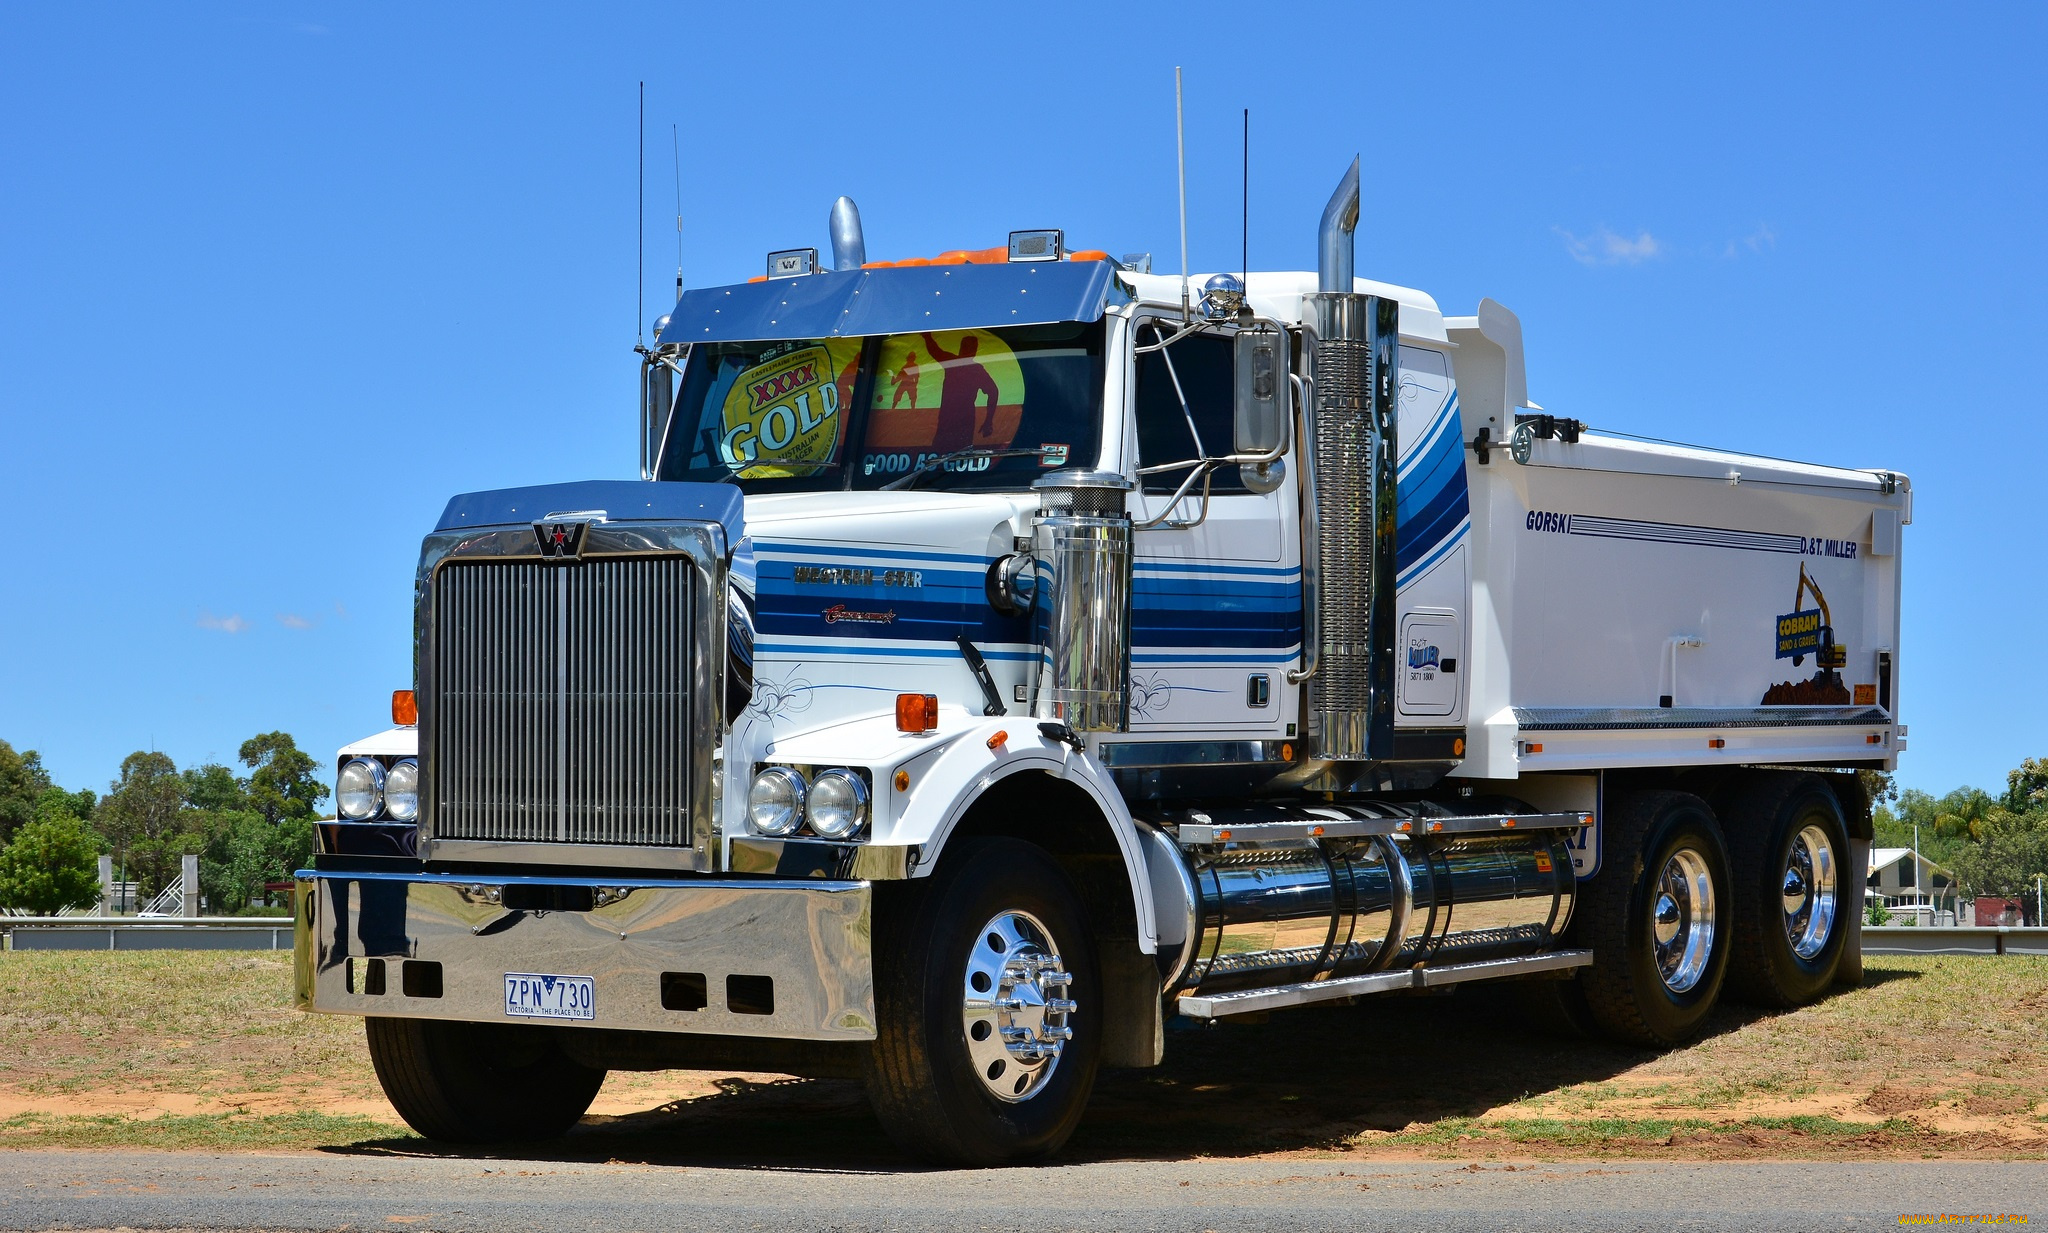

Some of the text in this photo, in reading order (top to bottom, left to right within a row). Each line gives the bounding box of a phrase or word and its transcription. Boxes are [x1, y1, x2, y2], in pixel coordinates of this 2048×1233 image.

[751, 359, 790, 379] CASTLEMAINE
[753, 363, 815, 407] XXXX
[720, 381, 839, 470] GOLD
[790, 446, 814, 461] AGER
[863, 454, 910, 473] GOOD
[943, 453, 990, 472] GOLD
[1526, 510, 1572, 534] GORSKI
[1825, 539, 1857, 559] MILLER
[794, 566, 923, 588] WESTERN STAR
[1779, 614, 1818, 637] COBRAM
[1779, 639, 1793, 651] SAND
[1799, 635, 1817, 648] GRAVEL
[508, 979, 590, 1009] ZPN 730
[509, 1006, 534, 1014] VICTORIA
[554, 1008, 571, 1016] PLACE
[573, 1009, 581, 1017] TO
